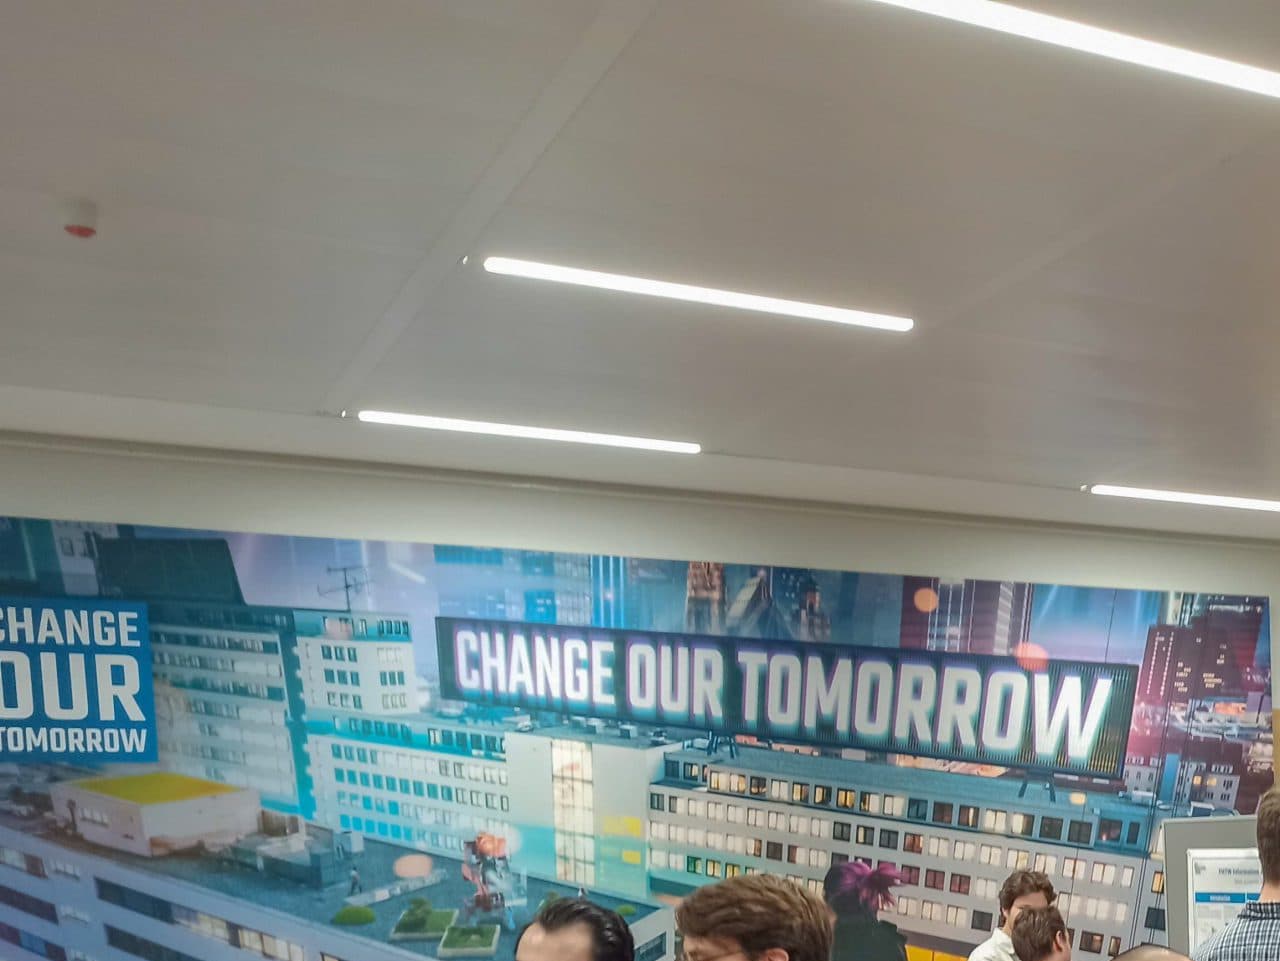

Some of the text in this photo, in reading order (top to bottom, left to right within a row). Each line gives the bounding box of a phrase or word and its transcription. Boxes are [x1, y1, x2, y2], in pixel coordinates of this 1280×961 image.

[0, 606, 141, 648] HANGE
[0, 650, 146, 722] OUR
[455, 629, 1113, 759] CHANGE OUR TOMORROW
